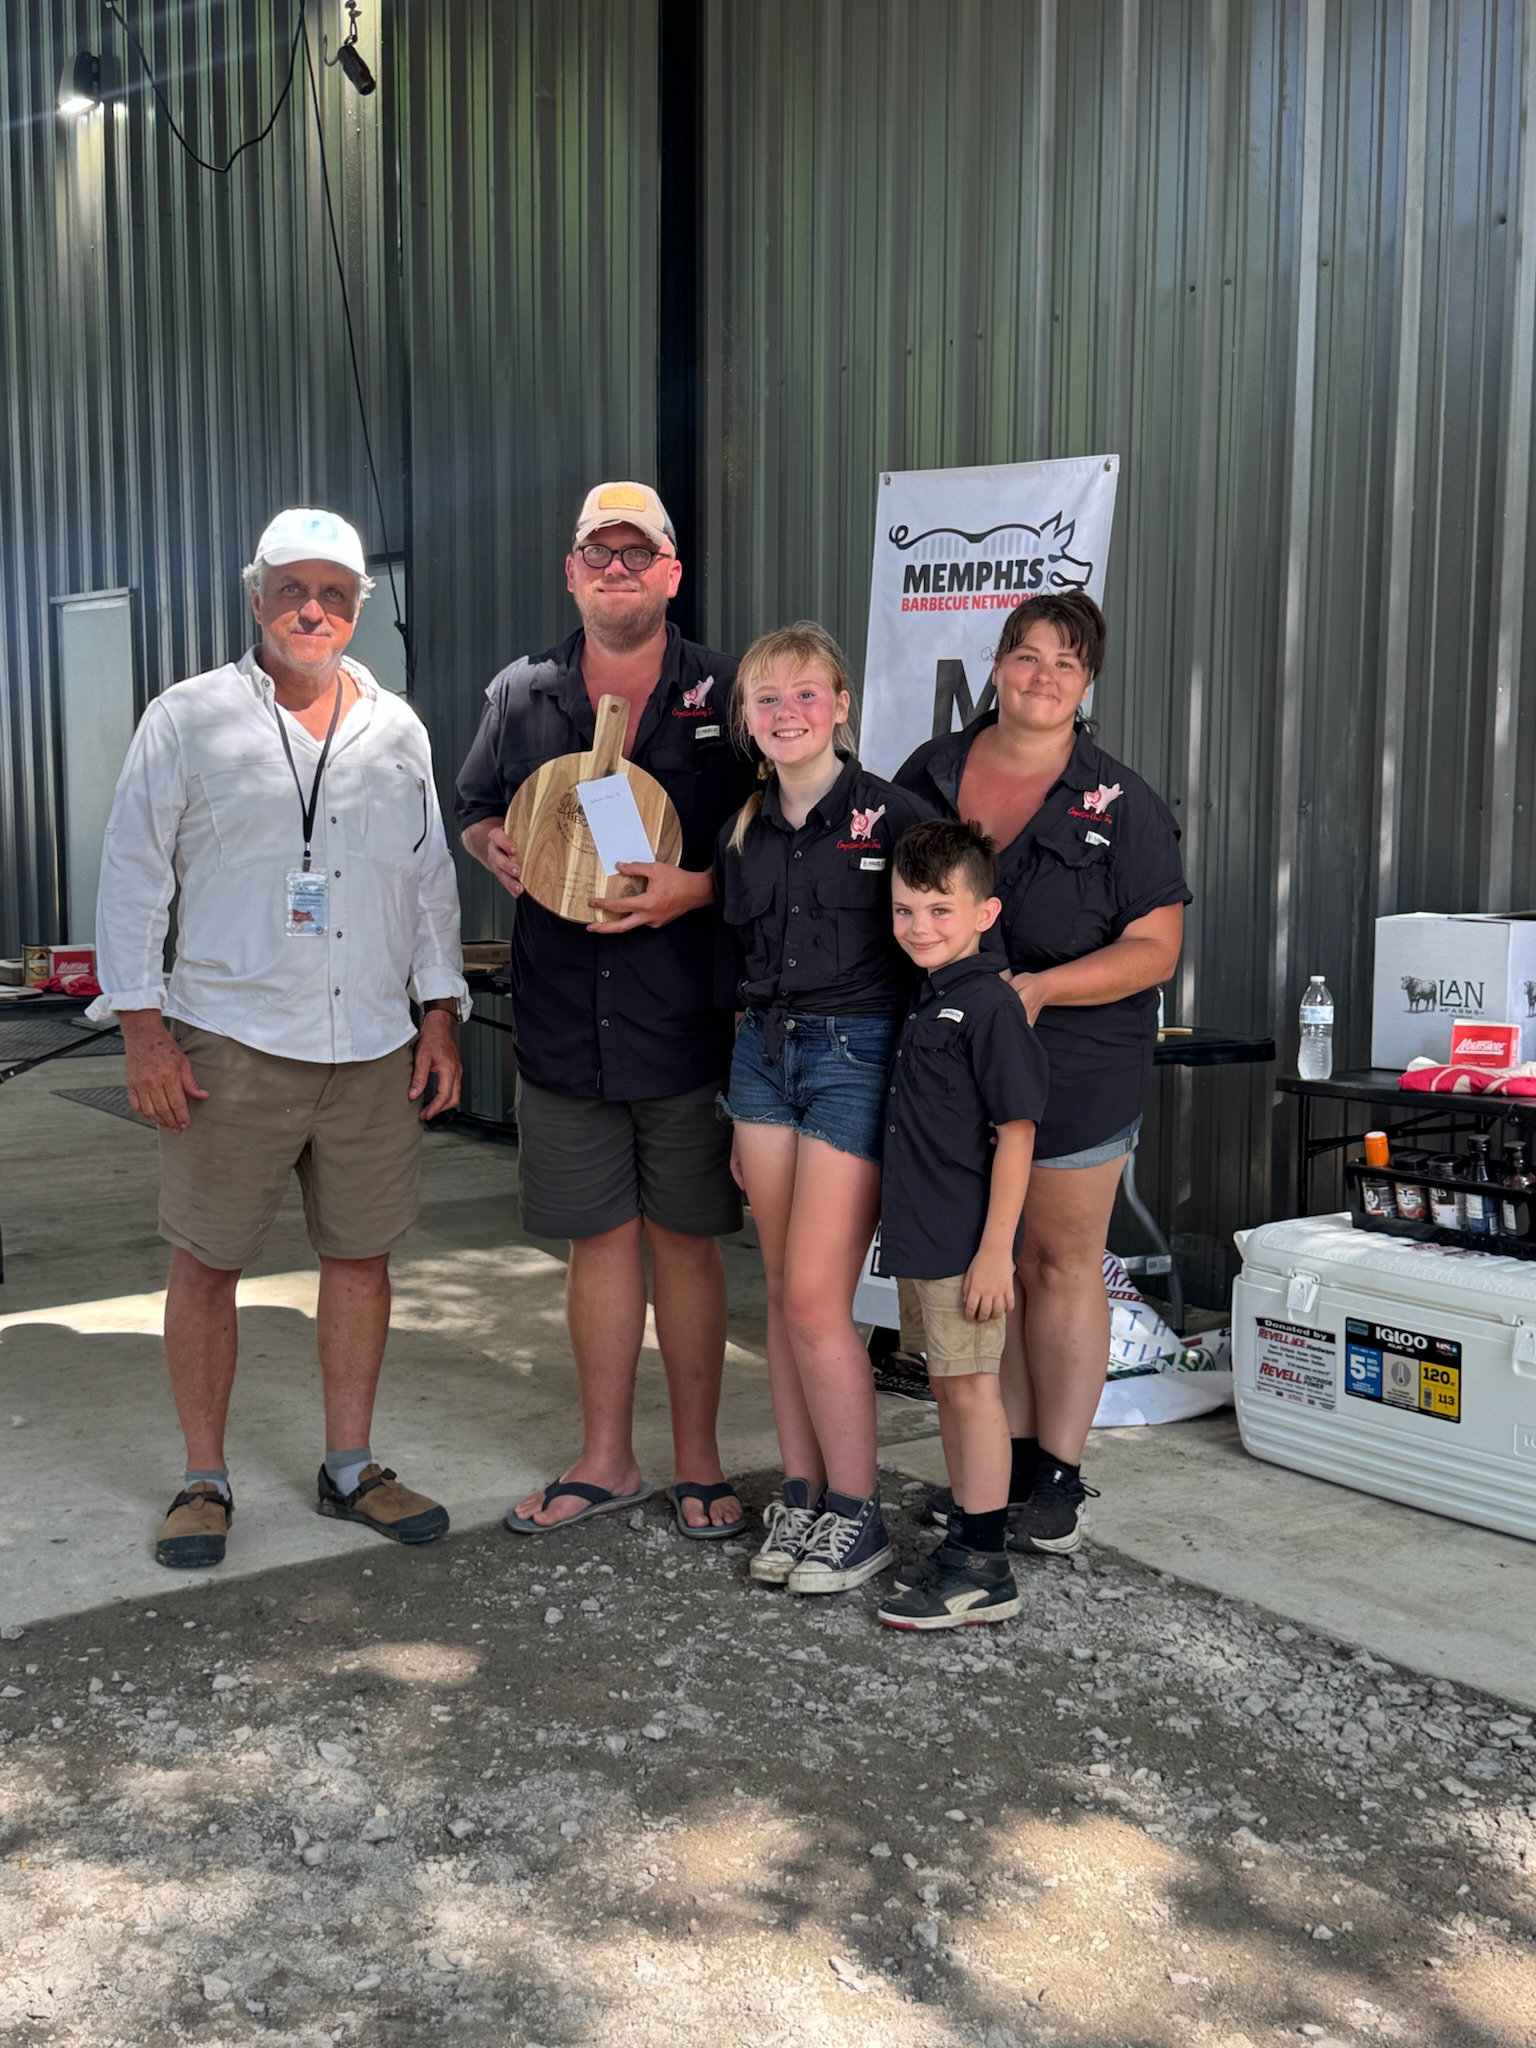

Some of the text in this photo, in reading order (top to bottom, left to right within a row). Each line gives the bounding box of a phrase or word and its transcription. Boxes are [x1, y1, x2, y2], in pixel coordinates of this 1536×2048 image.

[903, 558, 1044, 594] MEMPHIS
[901, 595, 969, 612] BARBECUE
[1439, 979, 1485, 1009] LAN
[1258, 1327, 1289, 1344] REVELL
[1306, 1344, 1336, 1356] Hardware
[1264, 1319, 1327, 1341] Donated by
[1375, 1326, 1428, 1350] IGLOO
[1259, 1362, 1303, 1385] REVELL
[1304, 1374, 1333, 1386] OUTDOOR
[1350, 1354, 1366, 1380] 5
[1423, 1367, 1450, 1385] 120
[1303, 1381, 1324, 1390] POWER
[1438, 1394, 1455, 1406] 113
